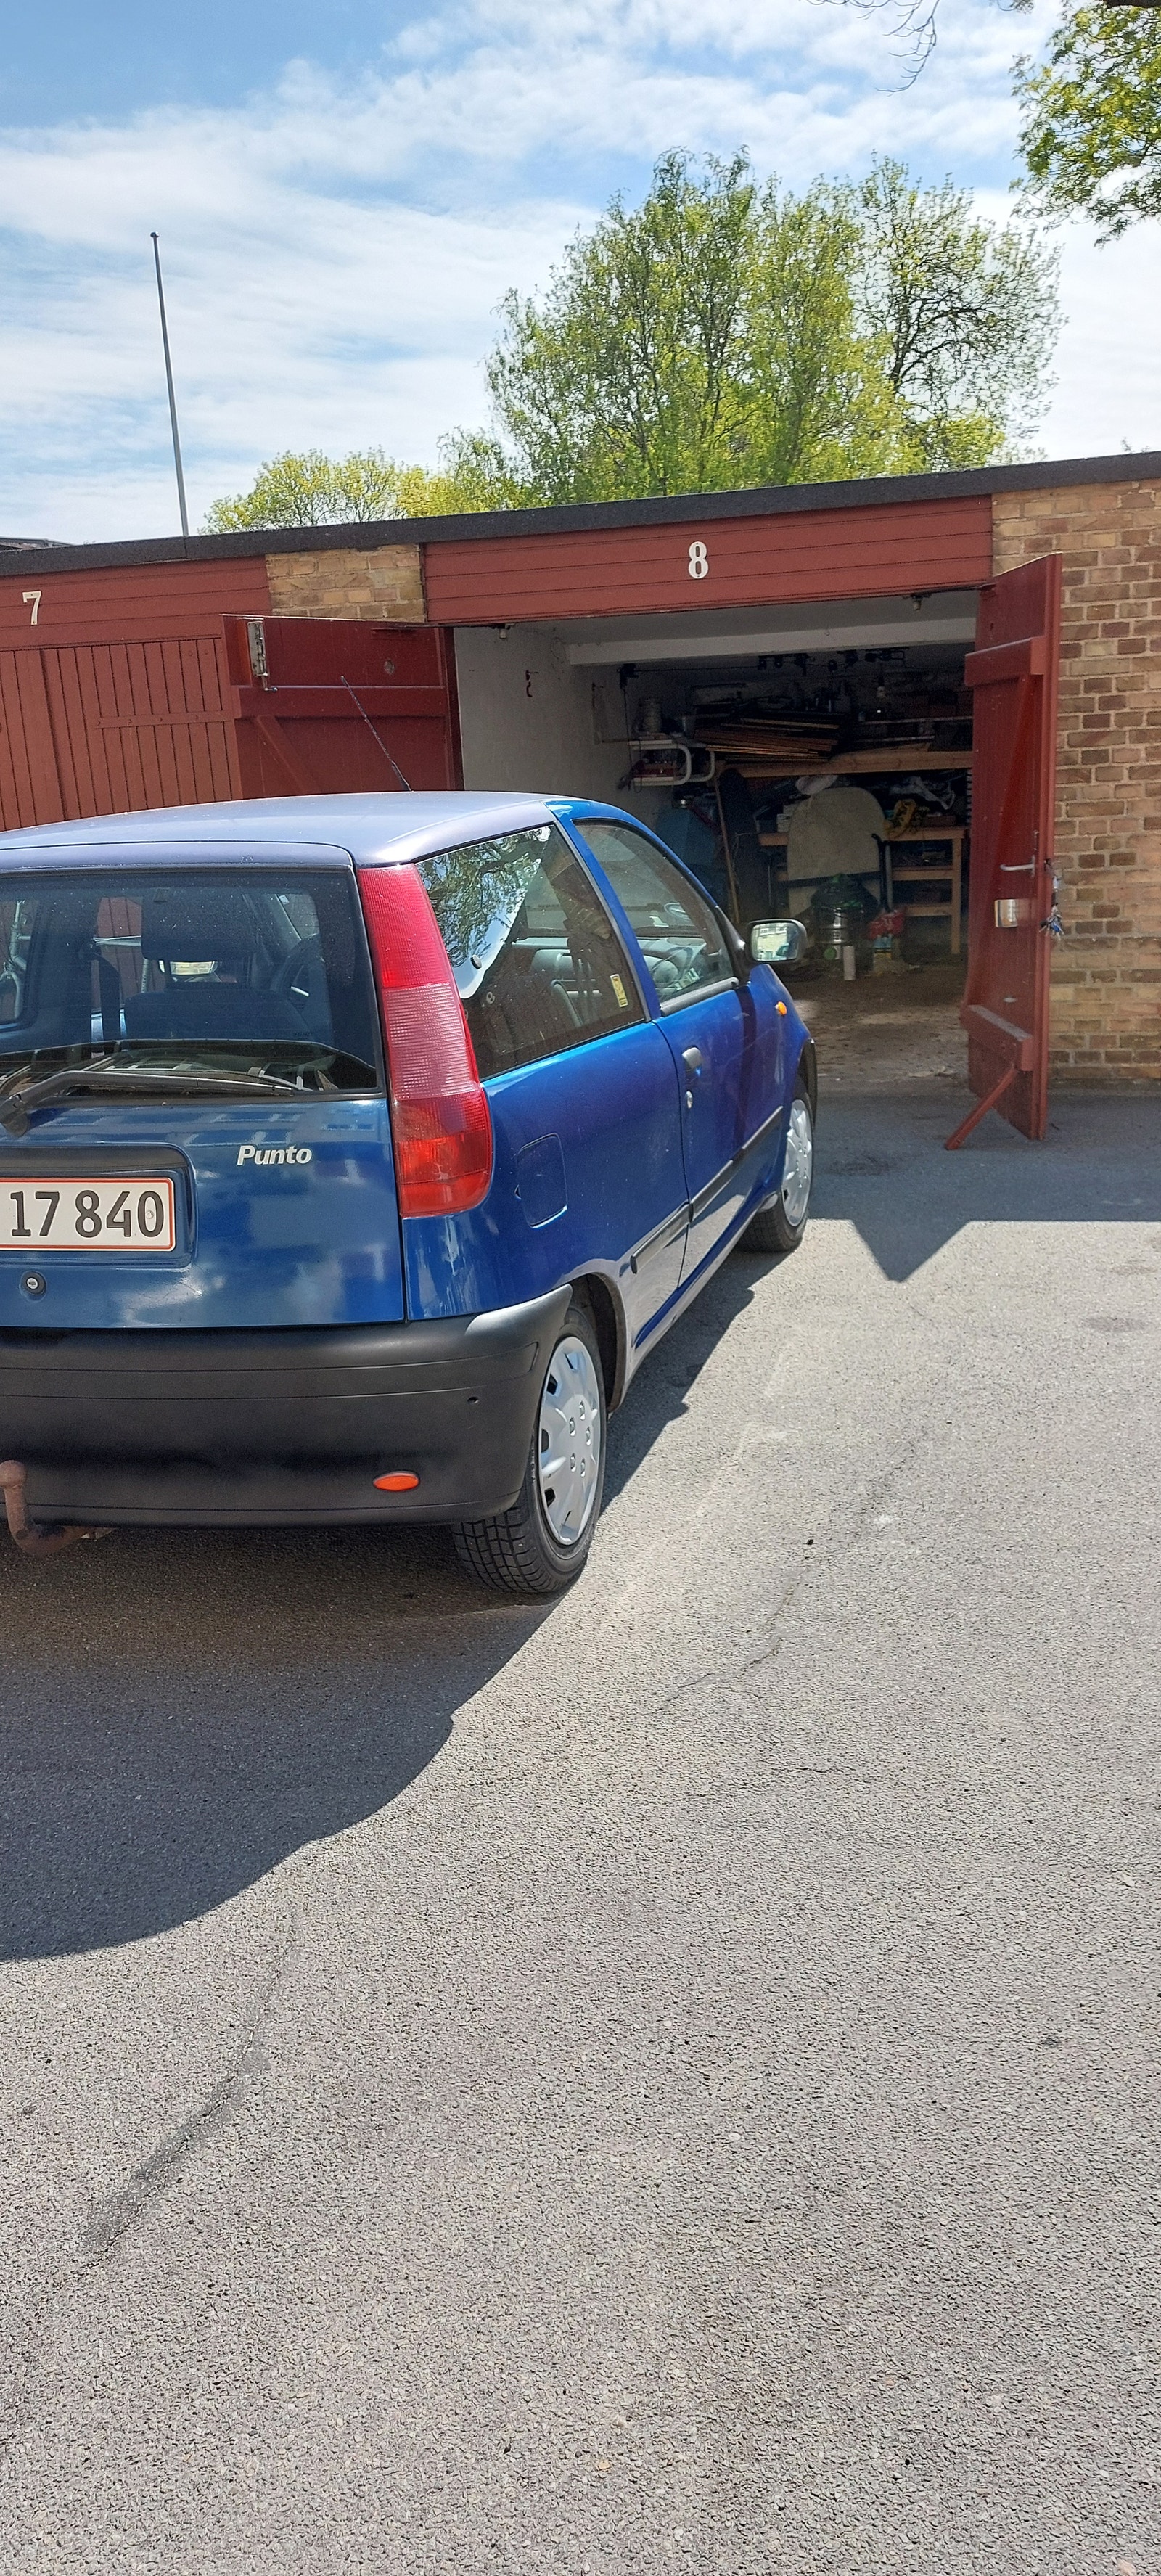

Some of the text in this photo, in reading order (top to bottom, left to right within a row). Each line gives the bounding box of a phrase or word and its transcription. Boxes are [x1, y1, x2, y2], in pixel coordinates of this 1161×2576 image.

[688, 541, 709, 579] 8
[22, 590, 41, 625] 7
[236, 1145, 313, 1165] Punto
[10, 1189, 164, 1238] 17 840
